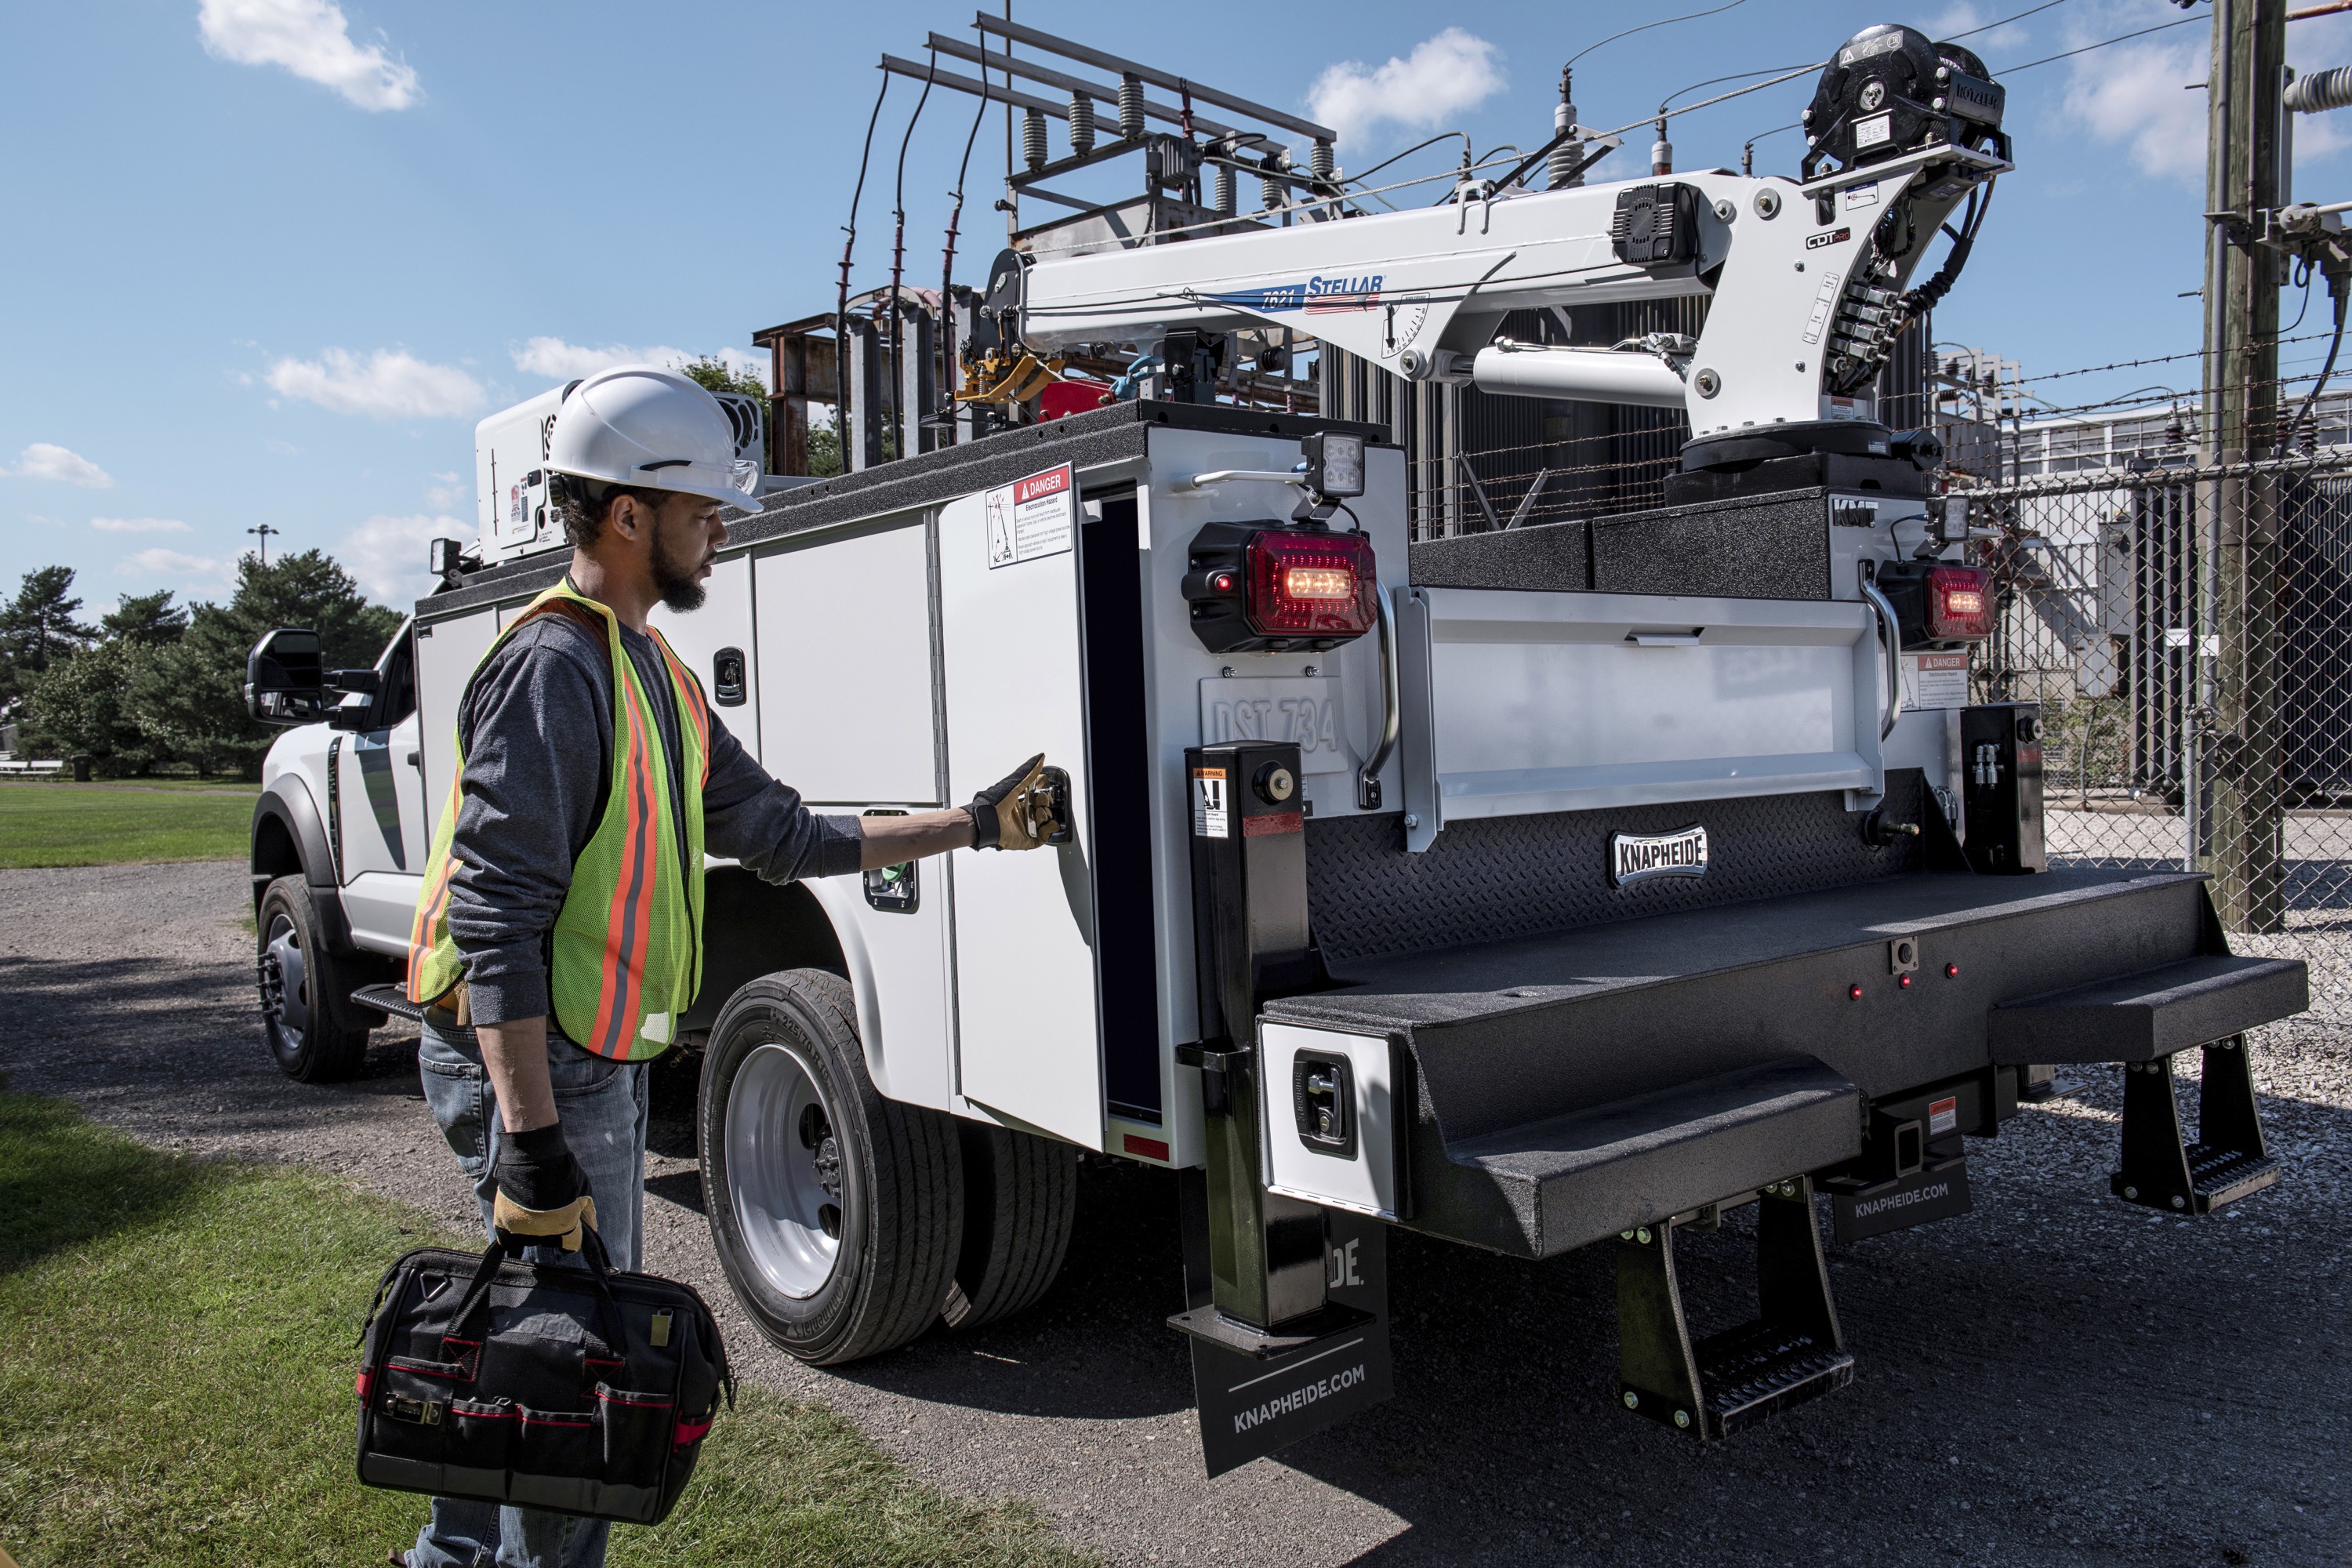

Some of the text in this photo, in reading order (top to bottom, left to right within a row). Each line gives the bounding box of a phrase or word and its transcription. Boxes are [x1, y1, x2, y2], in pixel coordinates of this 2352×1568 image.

[1807, 231, 1836, 249] CDT
[1308, 275, 1384, 299] STELLAR
[1261, 289, 1296, 310] 7621
[1030, 474, 1061, 495] DANGER
[1025, 495, 1058, 511] Electrocution Hazard
[1832, 499, 1878, 528] KMT
[1933, 658, 1960, 667] DANGER
[1279, 698, 1338, 753] 734
[1620, 834, 1703, 877] KNAPHEIDE
[1856, 1183, 1948, 1218] KNAPHEIDE.COM
[1234, 1364, 1365, 1433] KNAPHEIDE.COM
